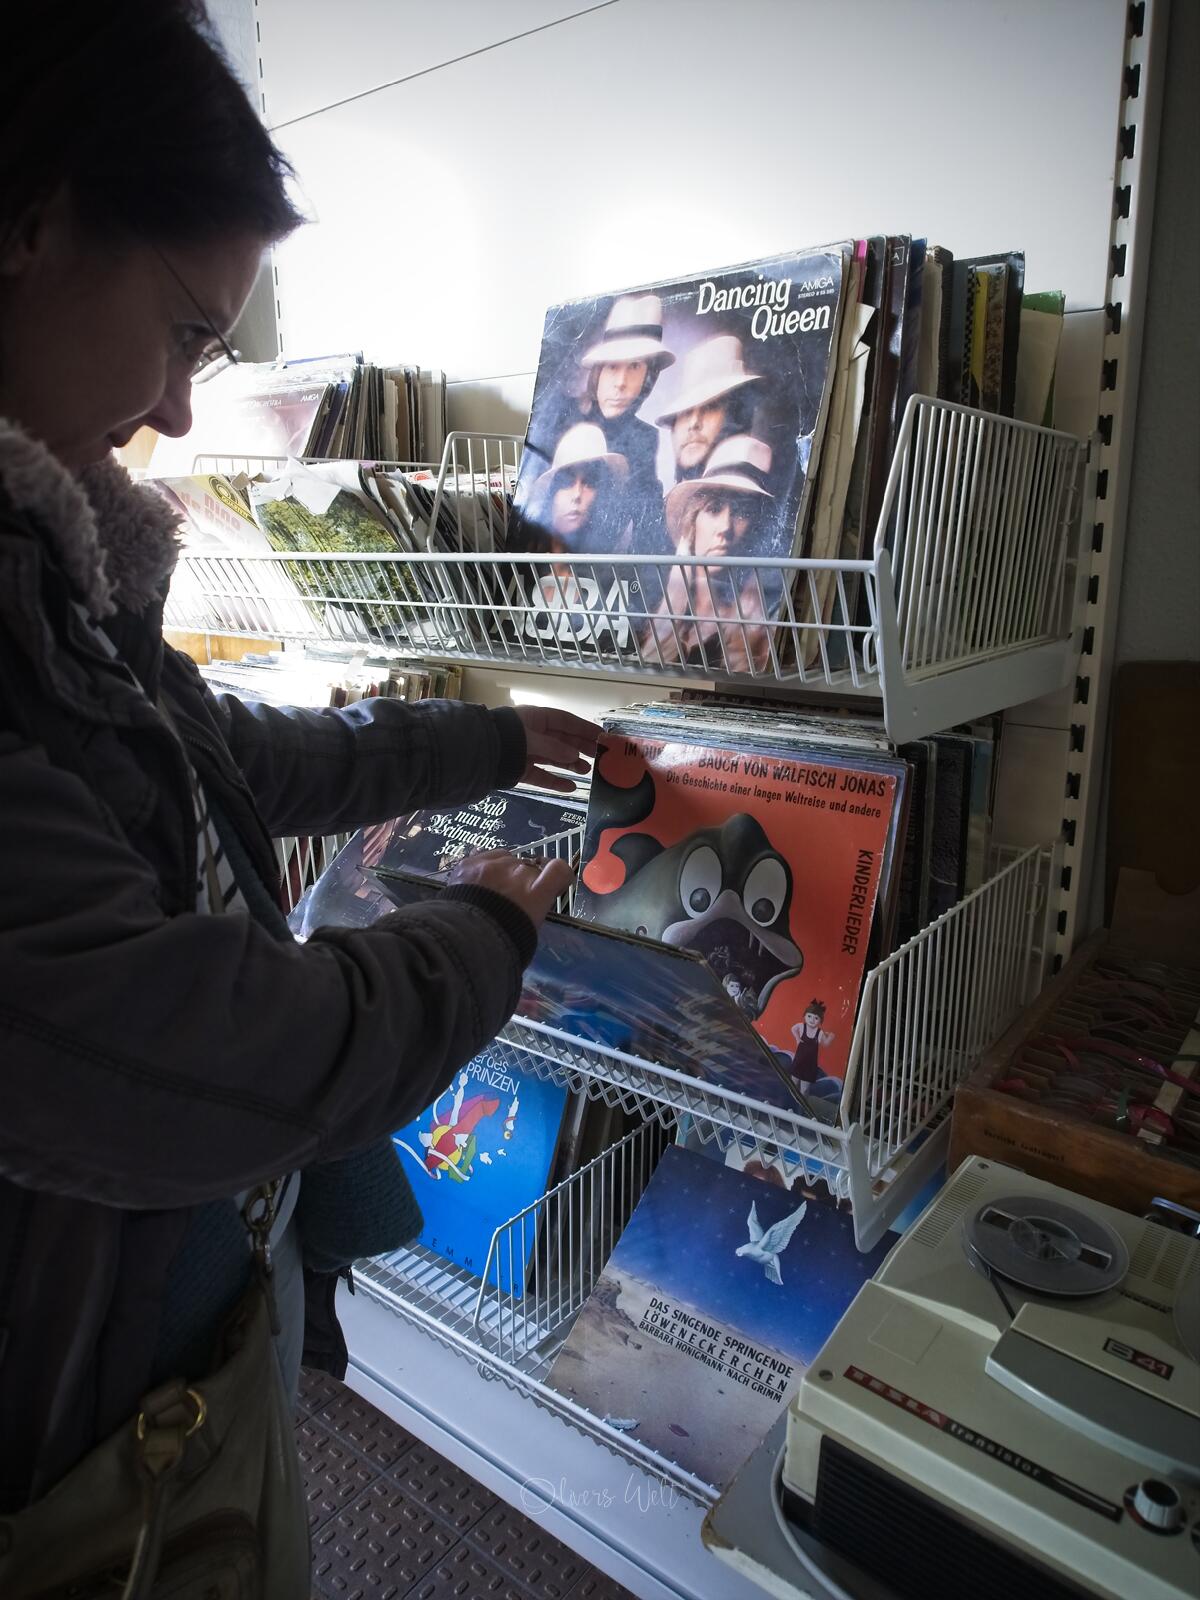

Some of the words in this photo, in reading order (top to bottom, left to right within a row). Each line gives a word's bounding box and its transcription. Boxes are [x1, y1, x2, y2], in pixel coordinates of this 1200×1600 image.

[696, 274, 793, 315] Dancing
[800, 276, 834, 293] AMIGA
[751, 304, 830, 342] Queen
[489, 574, 629, 648] ABBA
[624, 741, 639, 758] IM
[698, 755, 739, 775] BAUCH
[744, 759, 769, 778] VON
[773, 764, 837, 790] WALFISCH
[840, 774, 886, 798] JONAS
[468, 795, 509, 818] Bald
[666, 770, 680, 784] Die
[682, 772, 728, 793] Geschichte
[729, 782, 752, 796] einer
[753, 784, 782, 803] langen
[785, 790, 826, 809] Weltreise
[829, 800, 847, 813] und
[848, 802, 881, 819] andere
[454, 810, 482, 828] nun
[562, 811, 587, 824] ETERN
[841, 849, 874, 956] KINDERLIEDER
[465, 1061, 520, 1096] PRINZEN
[649, 1297, 670, 1315] DAS
[671, 1309, 722, 1342] SINGENDE
[723, 1336, 794, 1379] SPRINGENDE
[639, 1321, 675, 1346] BARBARA
[675, 1341, 724, 1373] HONIGMANN
[726, 1368, 751, 1387] NACH
[751, 1382, 783, 1404] GRIMM
[950, 1422, 1041, 1478] transistor
